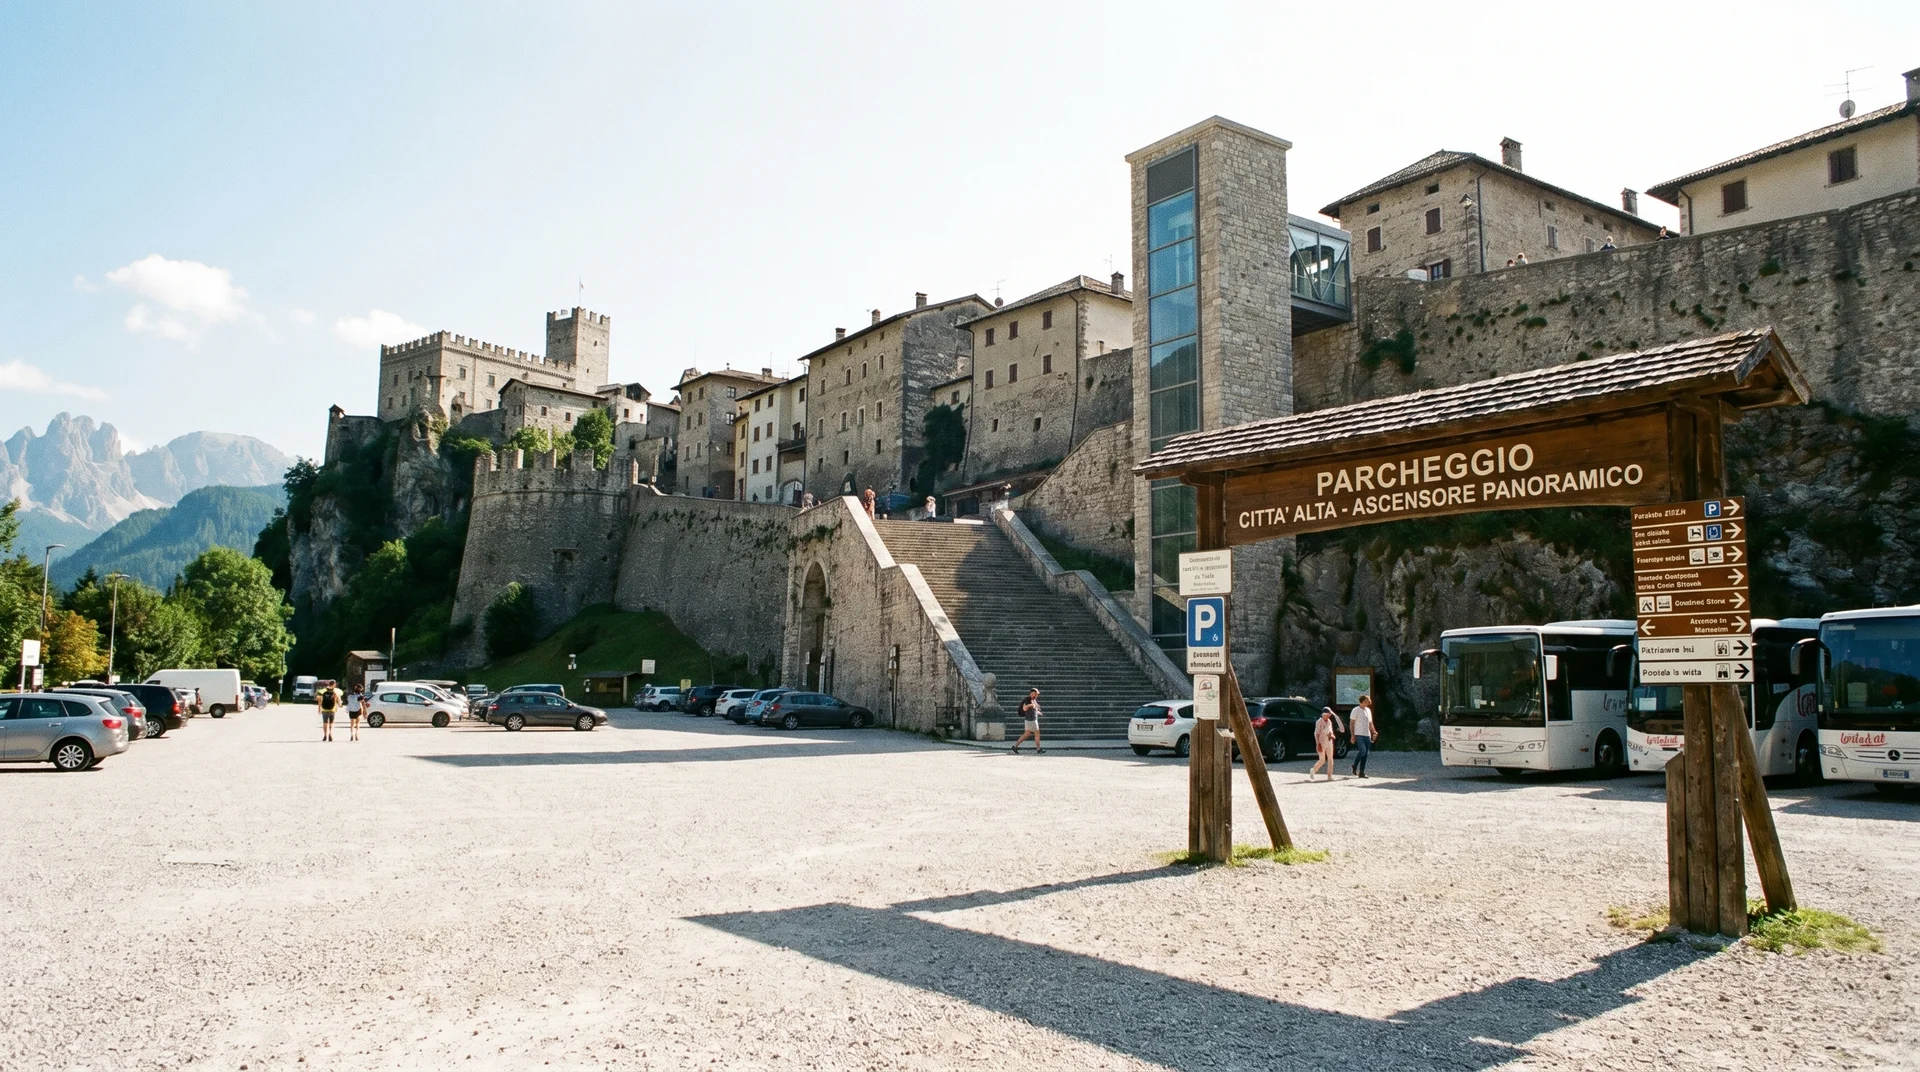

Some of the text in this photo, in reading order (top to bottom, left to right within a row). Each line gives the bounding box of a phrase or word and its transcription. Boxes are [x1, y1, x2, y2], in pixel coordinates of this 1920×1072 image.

[1316, 443, 1534, 496] PARCHEGGIO
[1239, 507, 1289, 529] CITTA'
[1293, 501, 1337, 523] ALTA
[1352, 483, 1476, 516] ASCENSORE
[1482, 463, 1643, 502] PANORAMICO
[1708, 504, 1717, 515] P
[1195, 604, 1216, 642] P
